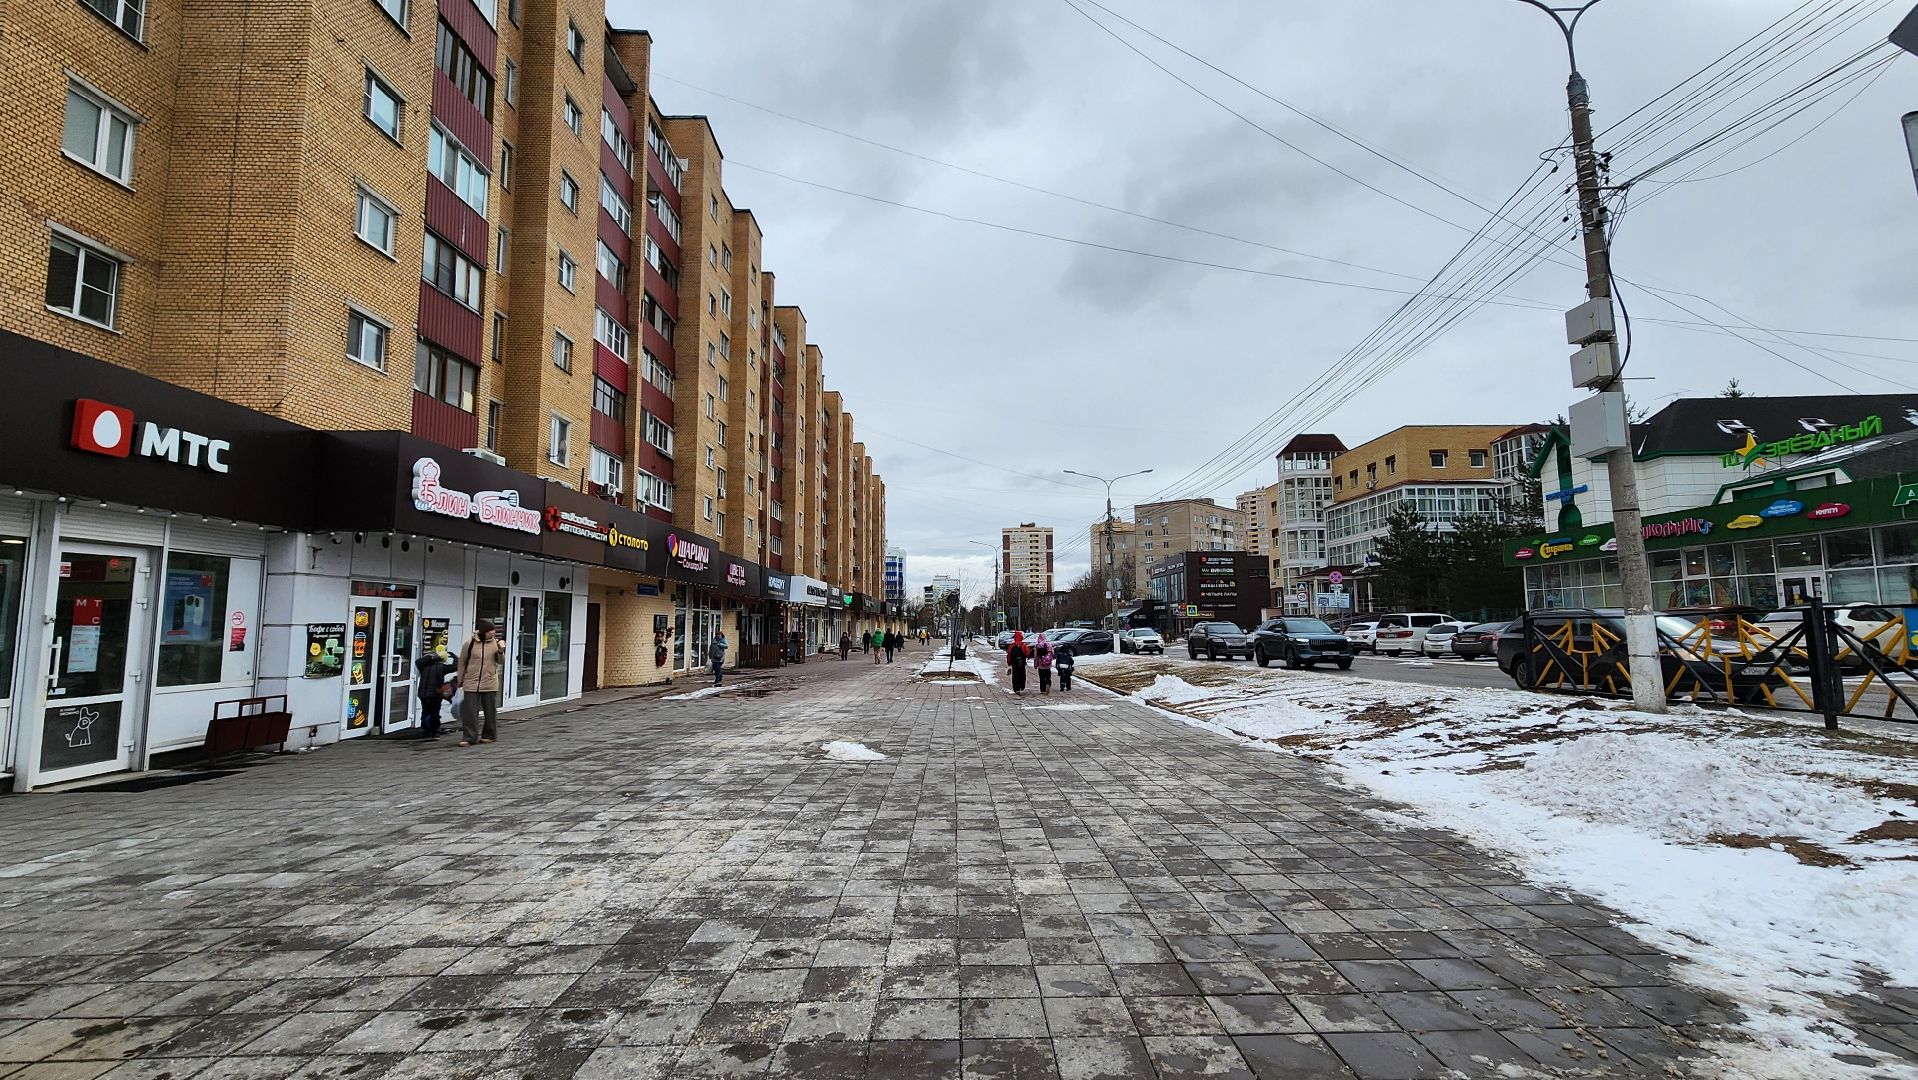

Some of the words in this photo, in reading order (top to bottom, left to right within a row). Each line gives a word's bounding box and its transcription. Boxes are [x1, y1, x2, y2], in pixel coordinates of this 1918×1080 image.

[140, 421, 230, 473] МТС
[678, 539, 709, 563] ШАРИКИ
[308, 624, 325, 634] Кофе
